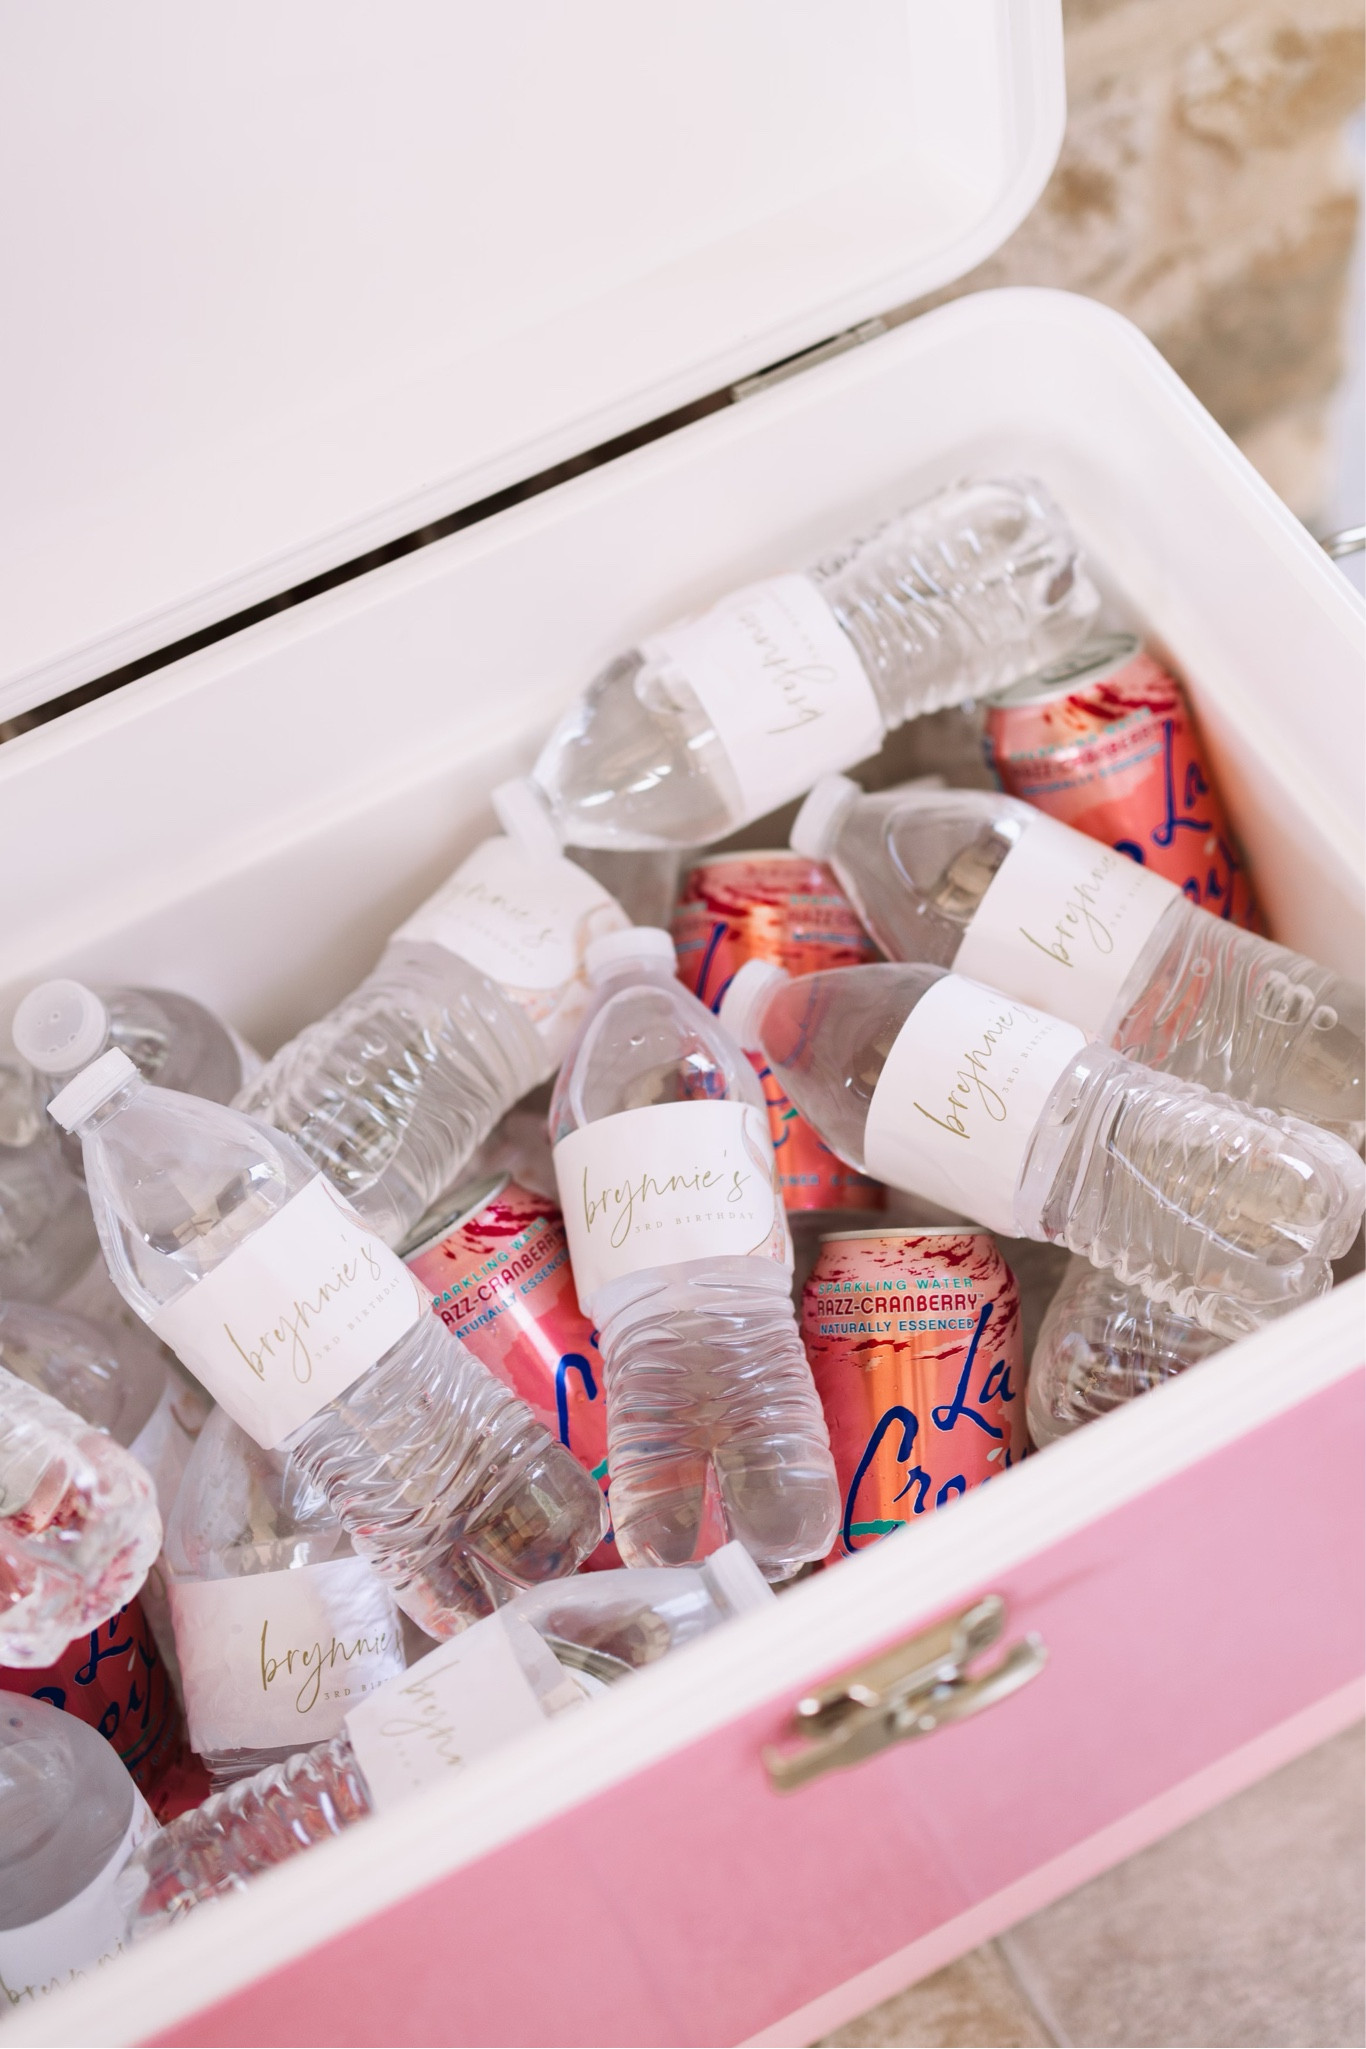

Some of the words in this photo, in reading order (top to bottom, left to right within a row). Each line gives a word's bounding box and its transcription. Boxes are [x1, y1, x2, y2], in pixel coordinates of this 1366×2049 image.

[583, 1149, 751, 1249] brynnie's
[634, 1221, 664, 1234] 3RD
[675, 1211, 755, 1226] BIRTHDAY
[346, 1276, 401, 1331] BIRTHDAY
[432, 1251, 510, 1308] PARKLING
[818, 1280, 908, 1294] SPARKLING
[916, 1278, 974, 1290] WATER
[223, 1233, 382, 1384] brynnie's
[455, 1292, 518, 1340] ATURALLY
[820, 1321, 892, 1334] NATURALLY
[899, 1318, 976, 1331] ESSENCED
[931, 1302, 1016, 1439] La
